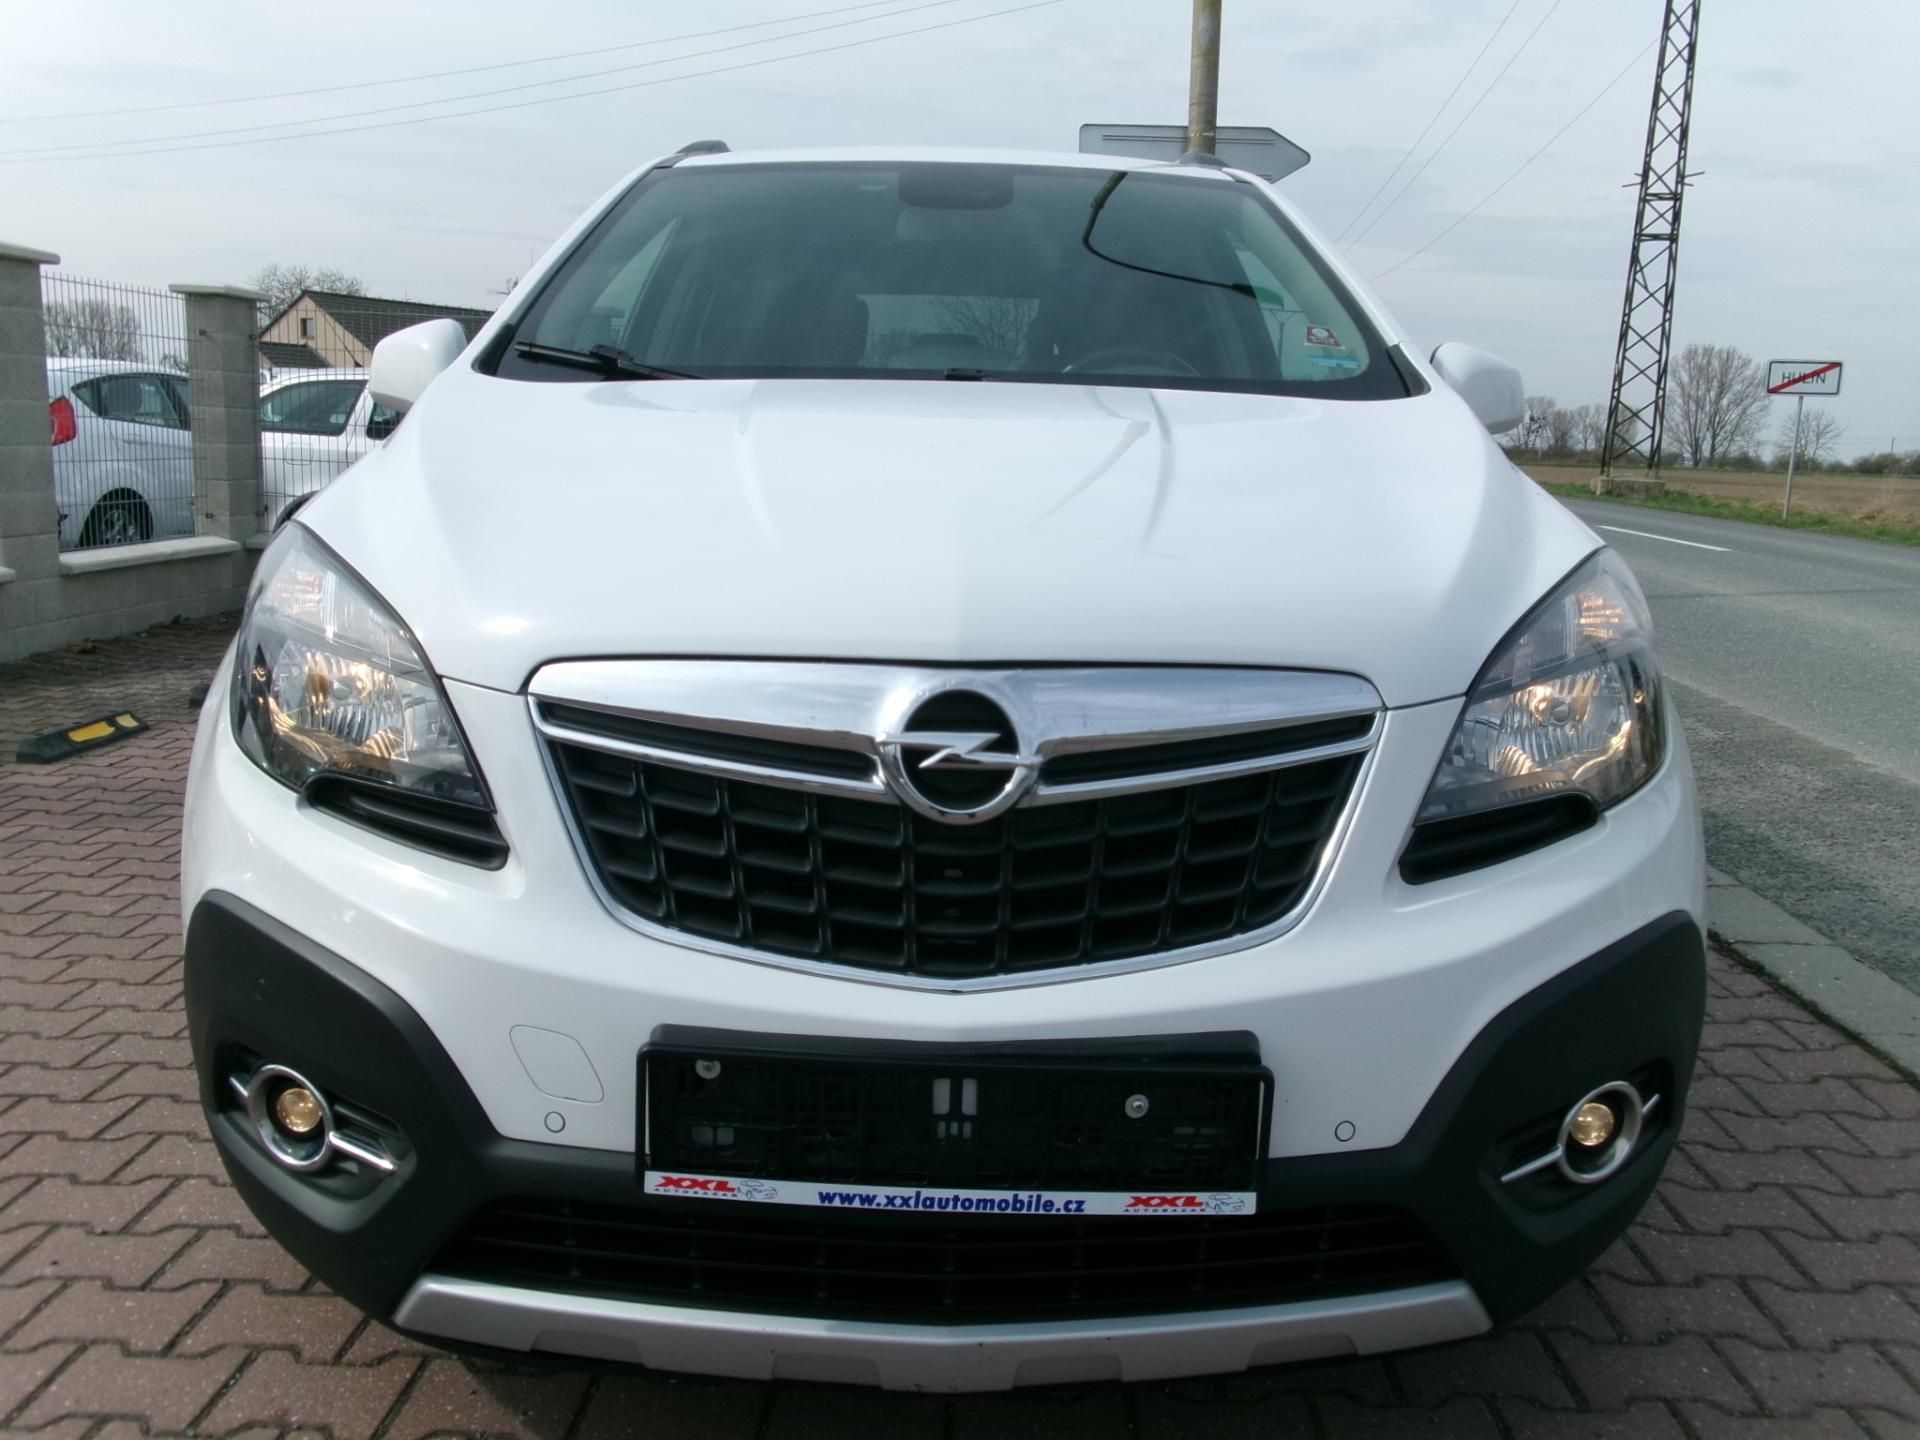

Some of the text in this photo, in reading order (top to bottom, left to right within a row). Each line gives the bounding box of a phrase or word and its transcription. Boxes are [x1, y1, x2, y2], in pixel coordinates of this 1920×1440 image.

[656, 1175, 736, 1193] XXL
[653, 1187, 738, 1198] AUTOBAZAR
[818, 1190, 1086, 1213] www.xxlautomobile.cz
[1125, 1195, 1205, 1208] XXL
